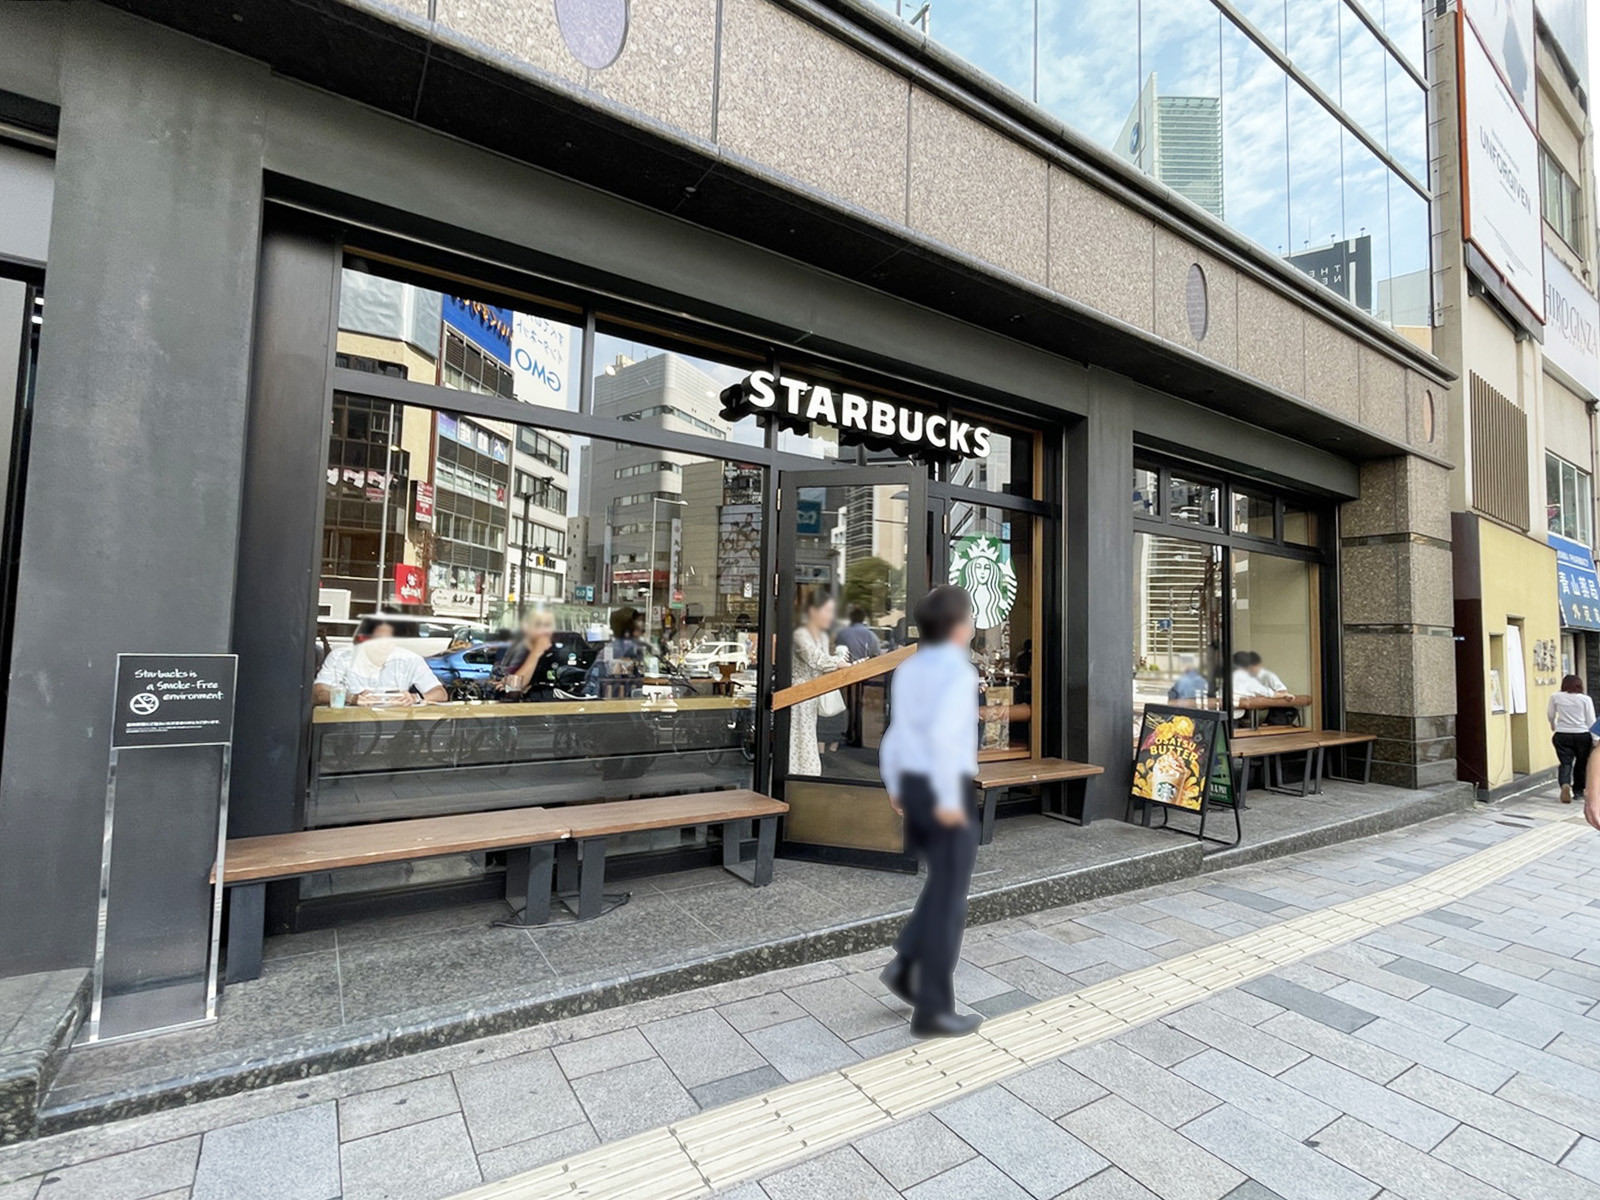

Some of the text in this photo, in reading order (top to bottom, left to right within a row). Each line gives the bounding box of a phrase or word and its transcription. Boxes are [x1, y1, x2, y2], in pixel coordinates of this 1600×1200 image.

[1479, 125, 1532, 215] UNFORGIVEN
[748, 369, 992, 459] STARBUCKS
[134, 668, 188, 679] Starbucks
[157, 680, 219, 691] Smoke-Free
[1155, 737, 1197, 751] OSATSU
[1150, 745, 1199, 761] BUTTER
